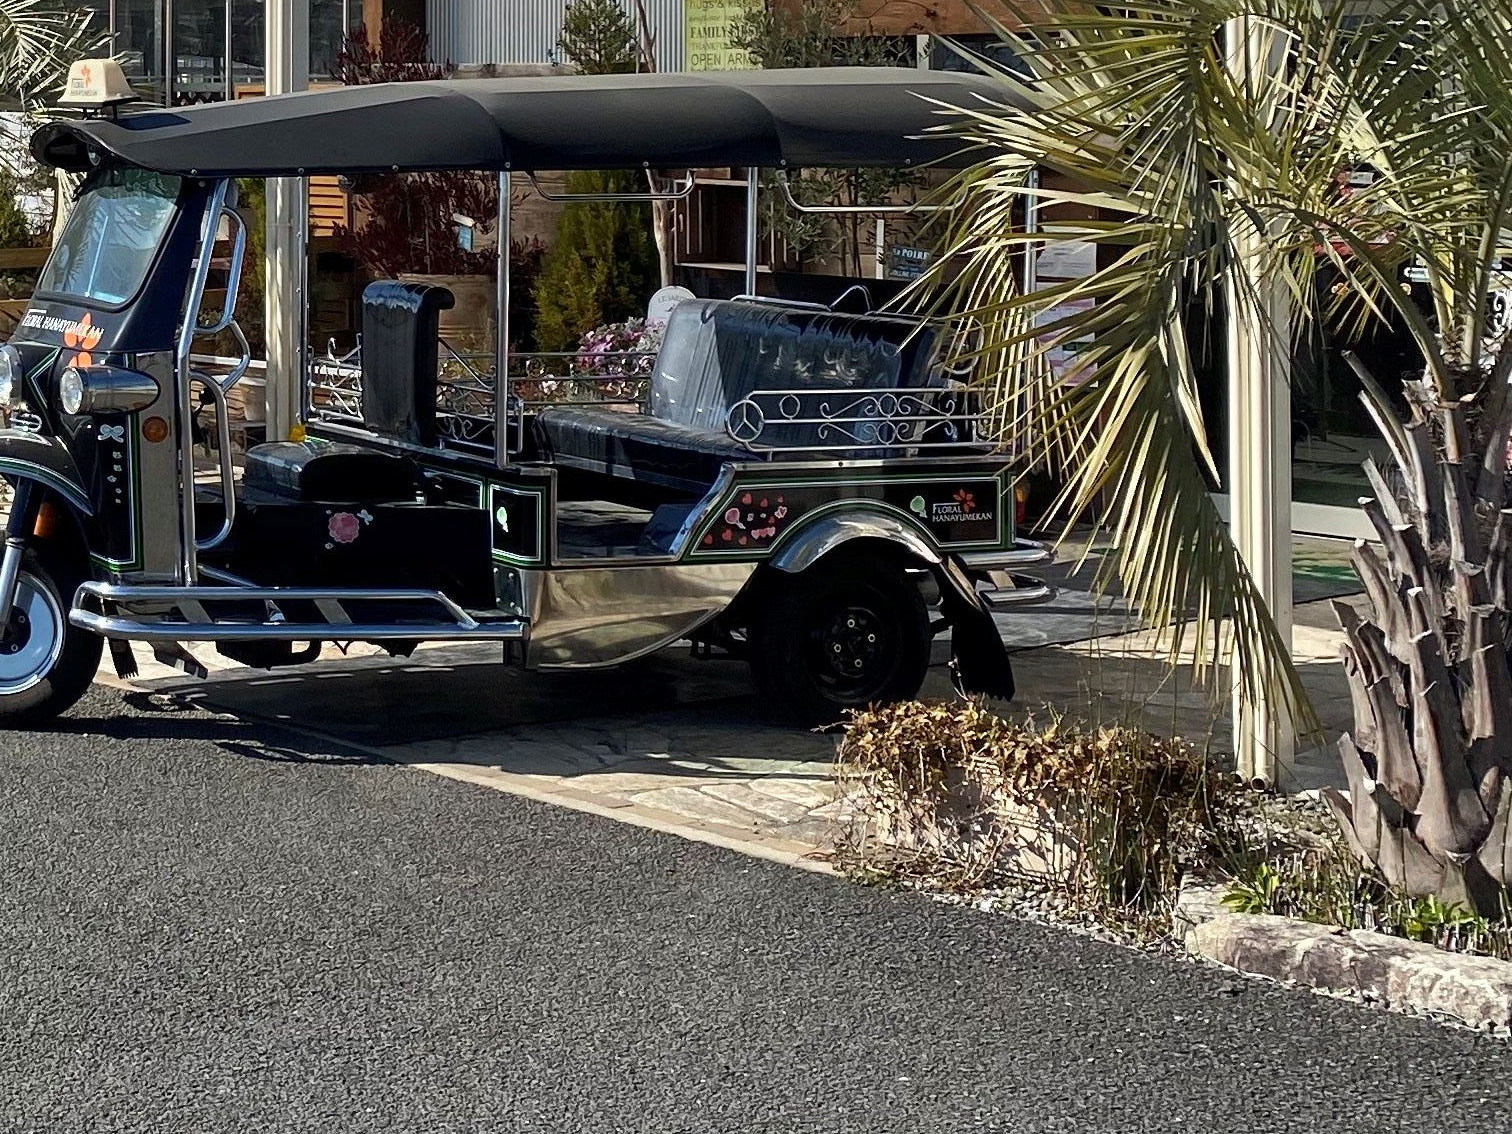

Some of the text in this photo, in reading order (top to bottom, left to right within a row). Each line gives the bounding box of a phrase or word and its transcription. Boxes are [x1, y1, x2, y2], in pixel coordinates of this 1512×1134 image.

[690, 27, 726, 38] FAMILY
[691, 53, 756, 65] OPEN ARM
[932, 503, 962, 514] FLORAL
[932, 512, 992, 522] HANAYUMEKAN
